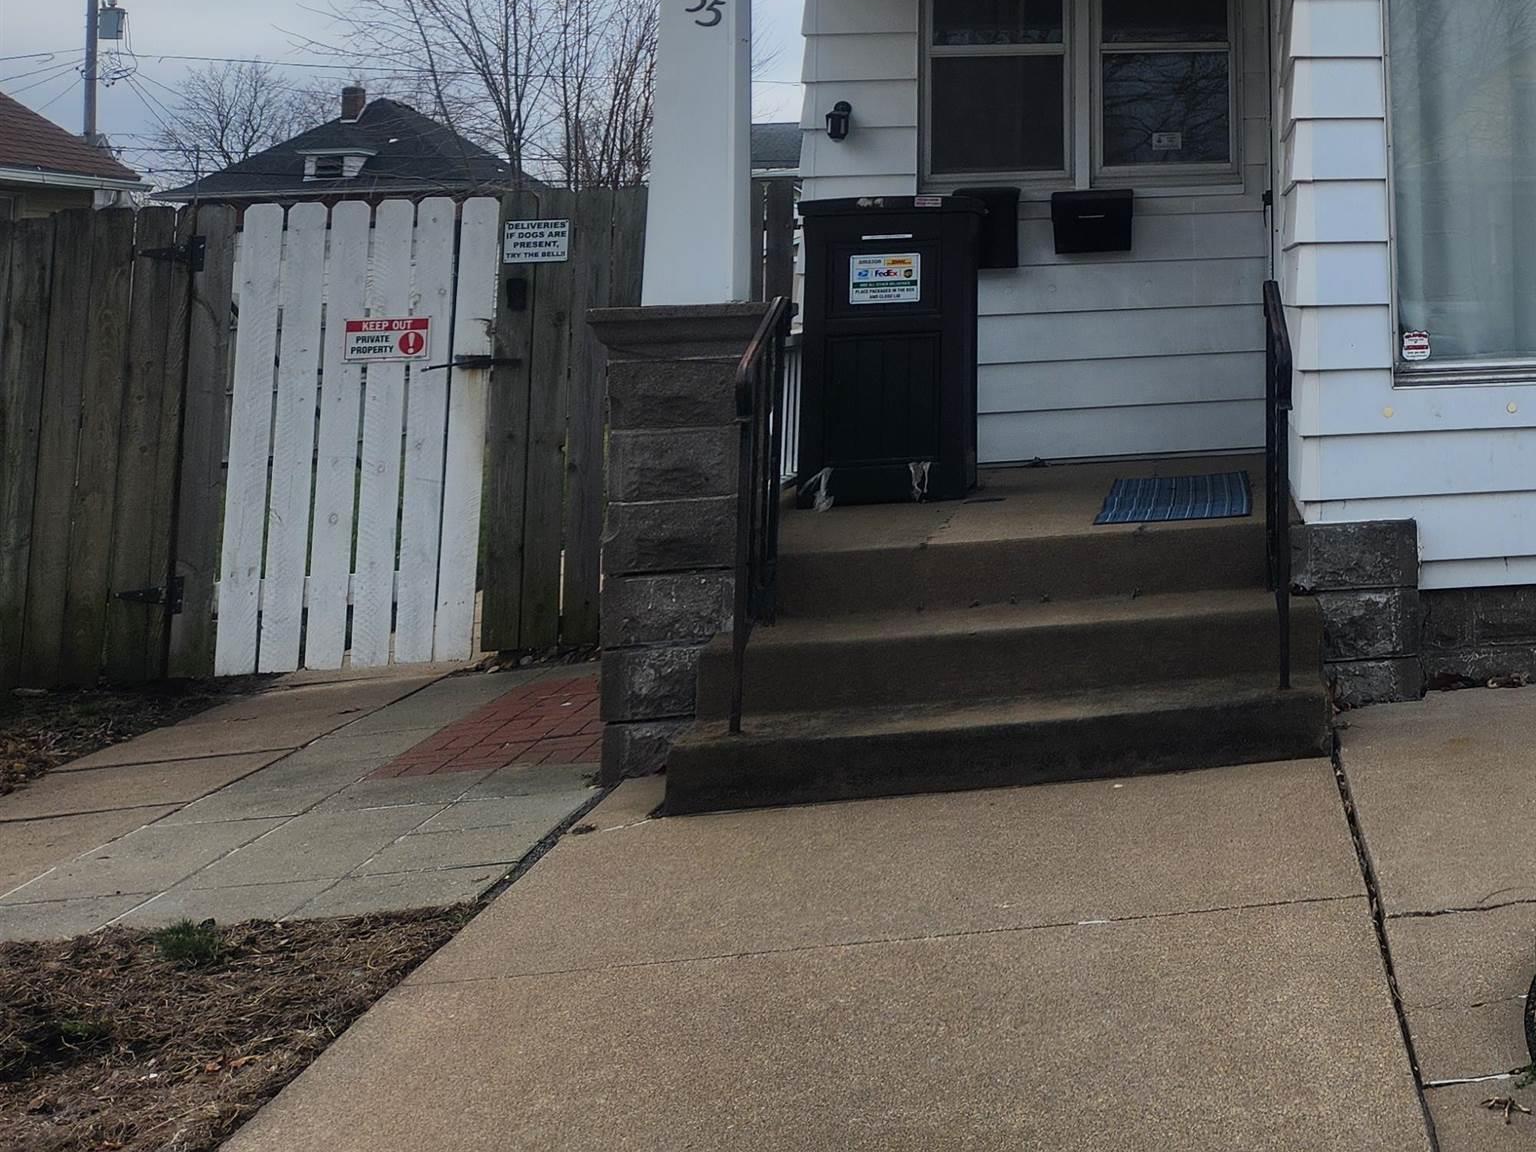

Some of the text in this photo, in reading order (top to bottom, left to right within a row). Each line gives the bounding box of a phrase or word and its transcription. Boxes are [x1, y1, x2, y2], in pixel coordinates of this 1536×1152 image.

[507, 221, 566, 230] DELIVERIES
[518, 231, 545, 239] DOGS
[547, 230, 567, 238] ARE
[874, 269, 897, 277] FedEx
[361, 320, 413, 331] KEEP OUT
[355, 335, 390, 344] PRIVATE
[350, 345, 394, 354] PROPERTY
